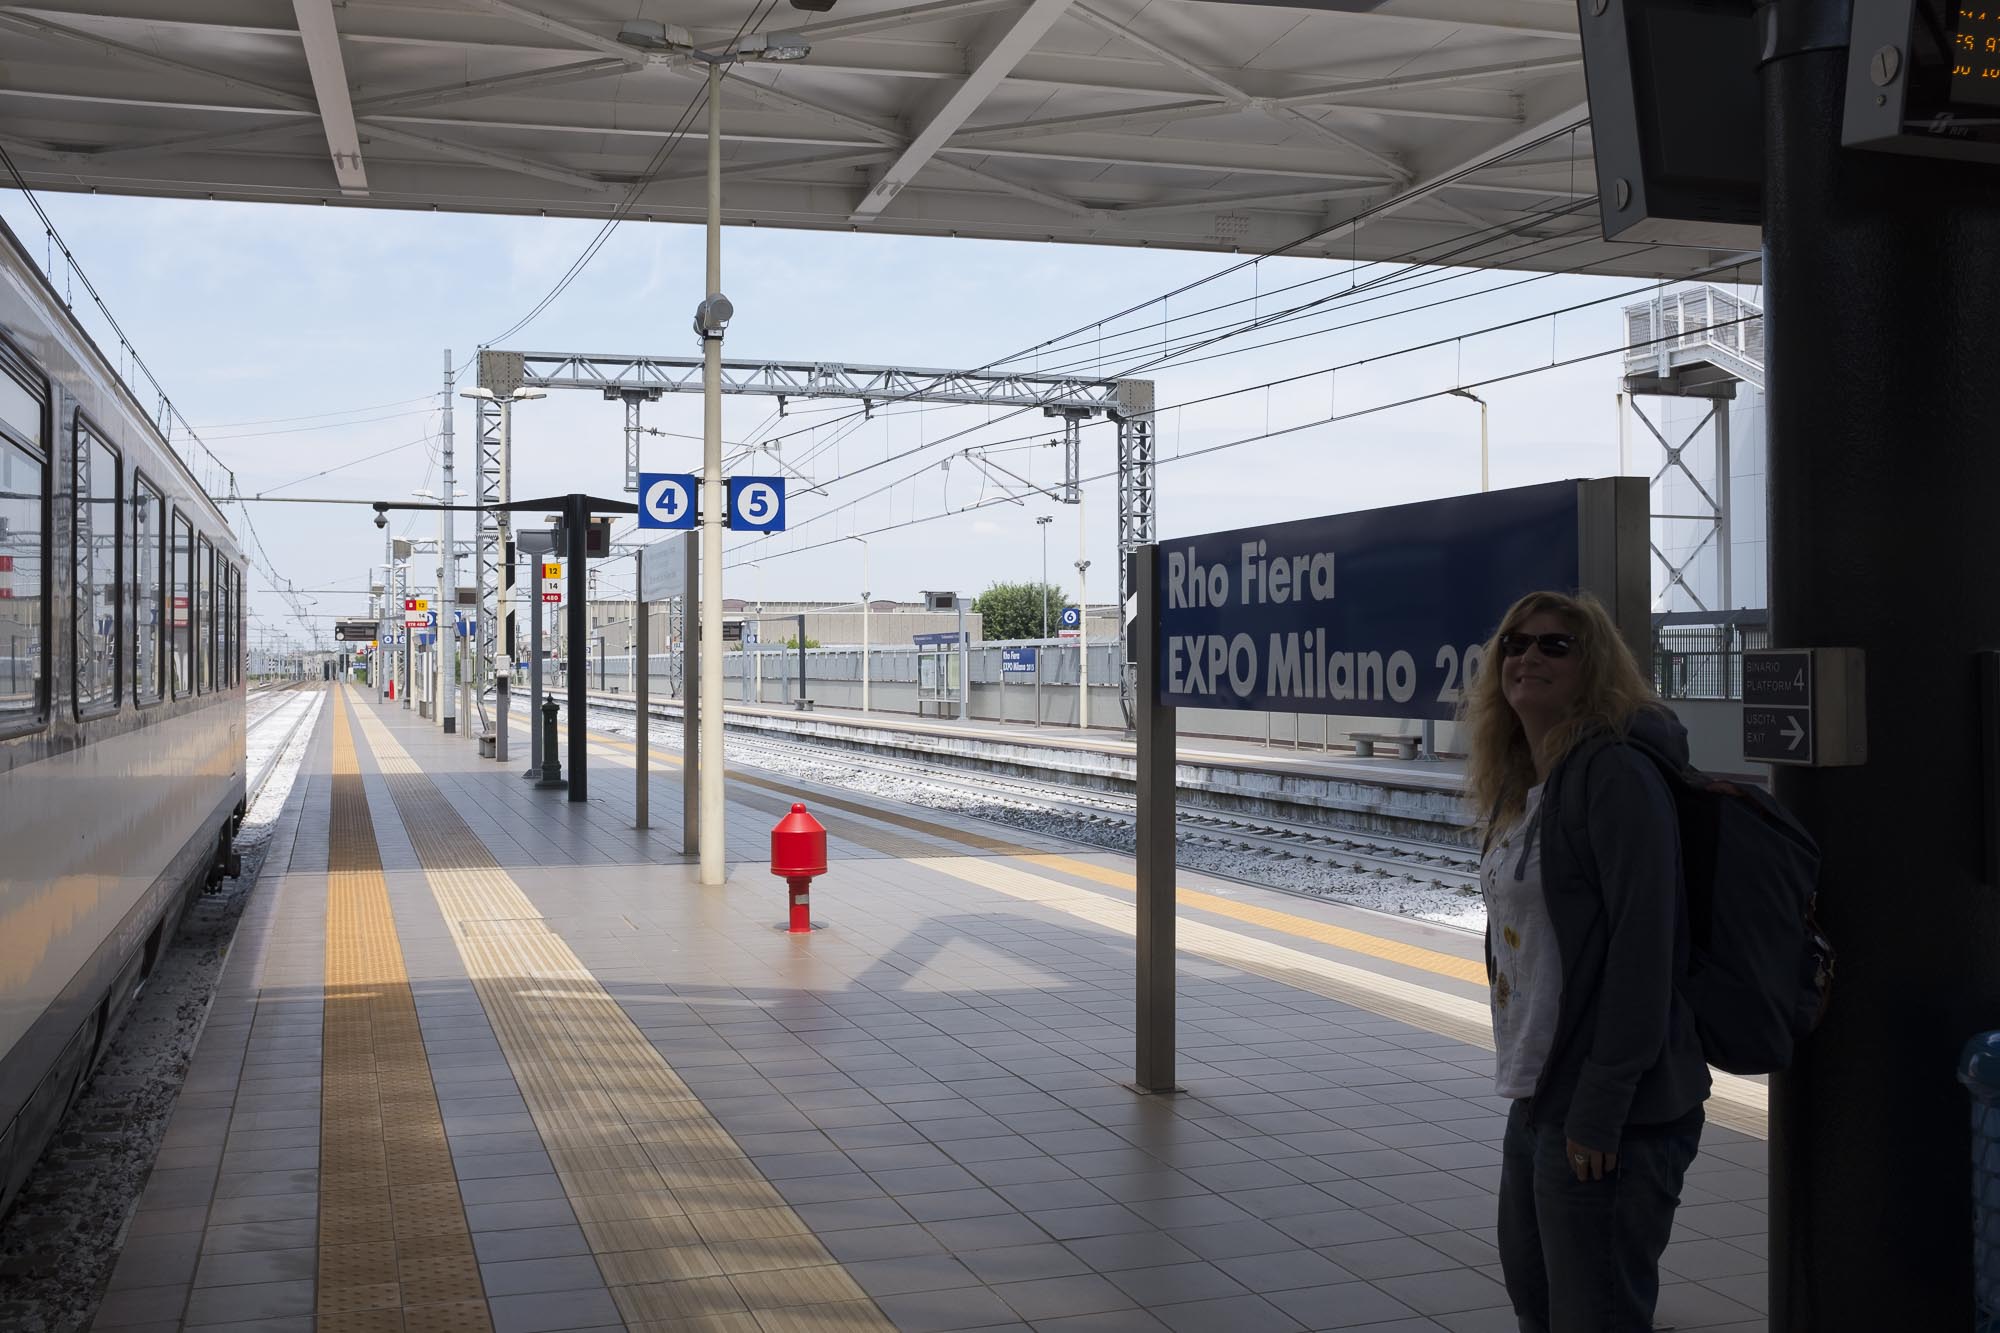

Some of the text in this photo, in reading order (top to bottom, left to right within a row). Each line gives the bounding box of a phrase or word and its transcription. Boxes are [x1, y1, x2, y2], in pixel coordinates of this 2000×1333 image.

[656, 487, 679, 516] 4
[748, 490, 769, 517] 5
[548, 567, 558, 575] 12
[1168, 538, 1336, 610] Rho Fiera
[549, 582, 559, 590] 14
[1066, 612, 1074, 621] 6
[1168, 631, 1258, 698] EXPO
[1266, 627, 1418, 704] Milano
[1746, 662, 1781, 673] BINARIO
[1793, 667, 1805, 692] 4
[1746, 680, 1792, 692] PLATFORM
[1746, 714, 1777, 726] USCITA
[1746, 731, 1766, 744] EXIT
